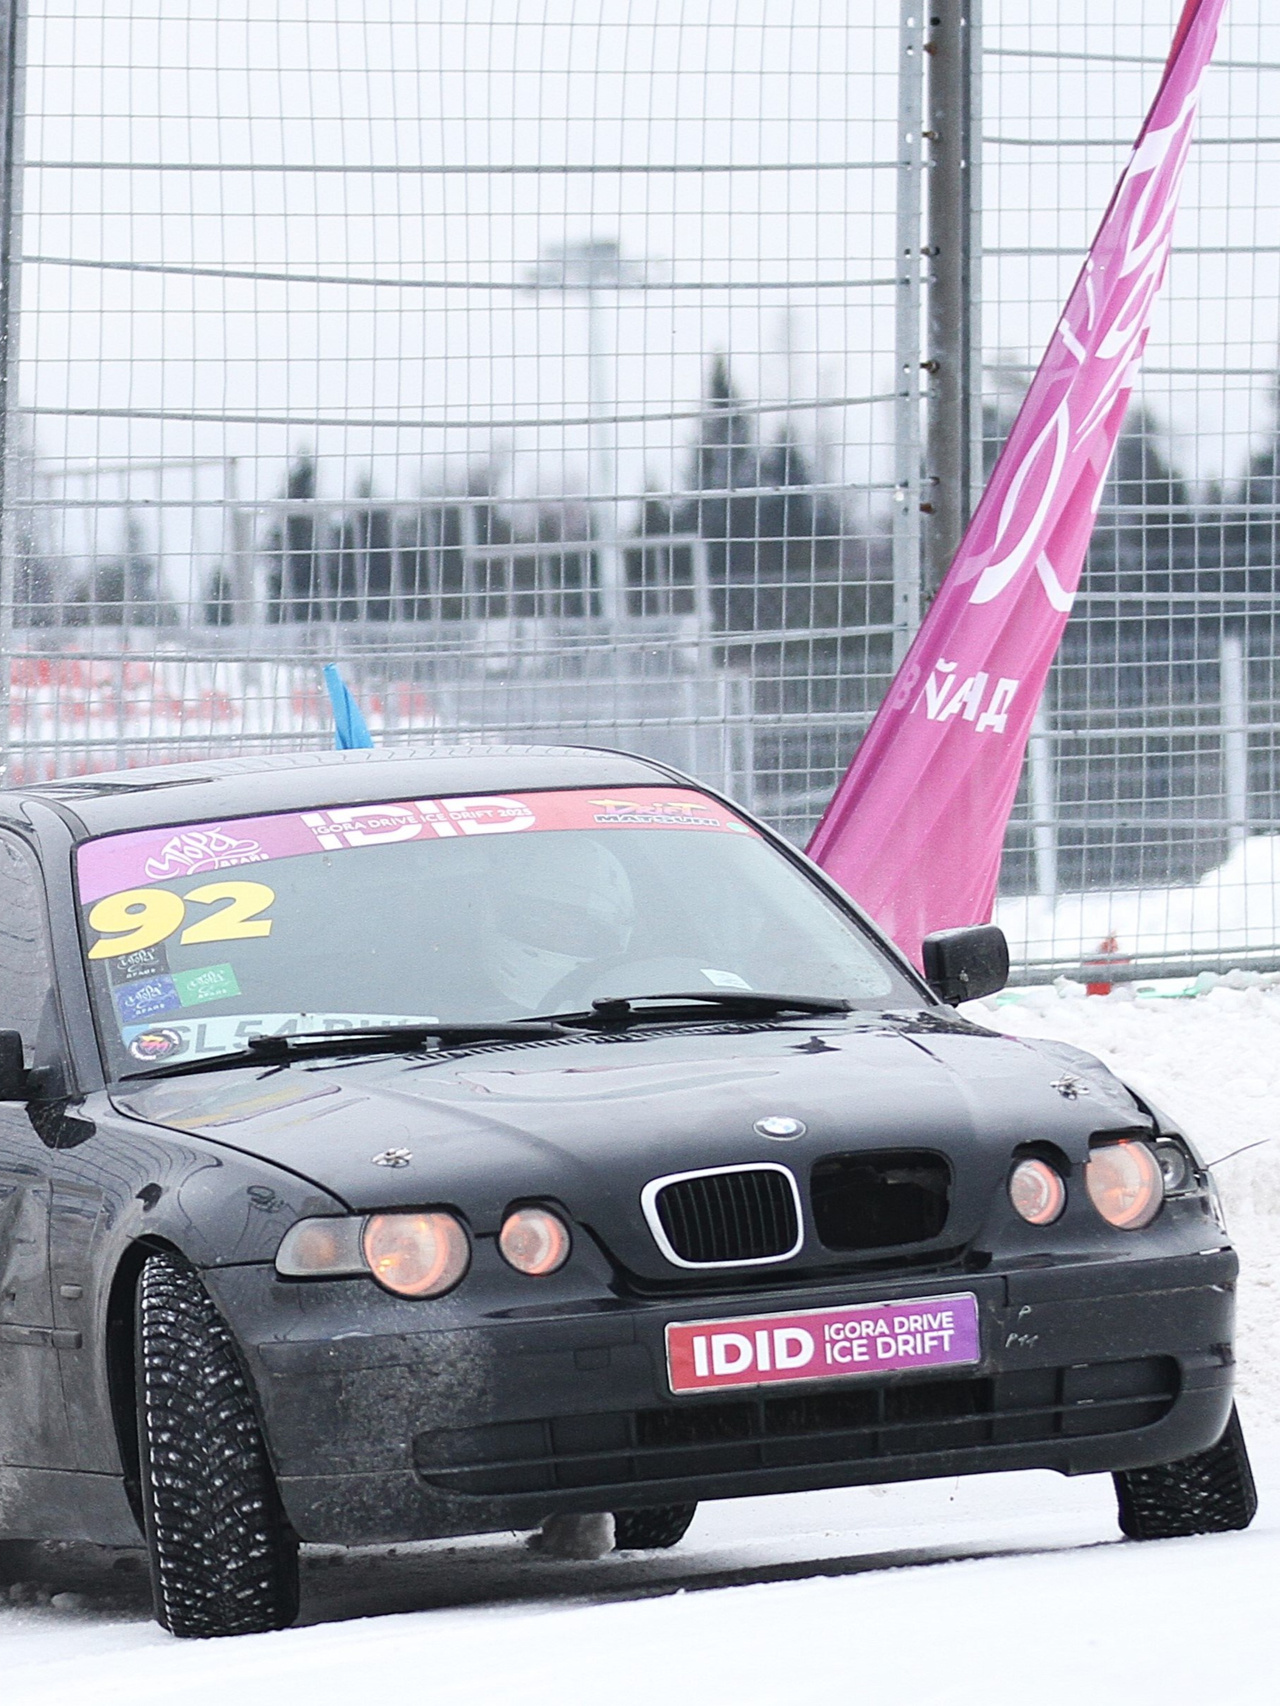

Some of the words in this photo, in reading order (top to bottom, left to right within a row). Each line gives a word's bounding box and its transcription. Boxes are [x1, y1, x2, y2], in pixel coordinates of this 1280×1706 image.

[311, 821, 367, 835] IGORA
[368, 815, 418, 829] DRIVE
[420, 812, 447, 822] ICE
[450, 809, 493, 820] DRIFT
[497, 808, 533, 817] 2025
[87, 881, 276, 960] 92
[824, 1318, 890, 1341] IGORA
[893, 1311, 954, 1334] DRIVE
[692, 1327, 815, 1377] IDID
[825, 1339, 870, 1364] ICE
[876, 1329, 954, 1359] DRIFT
